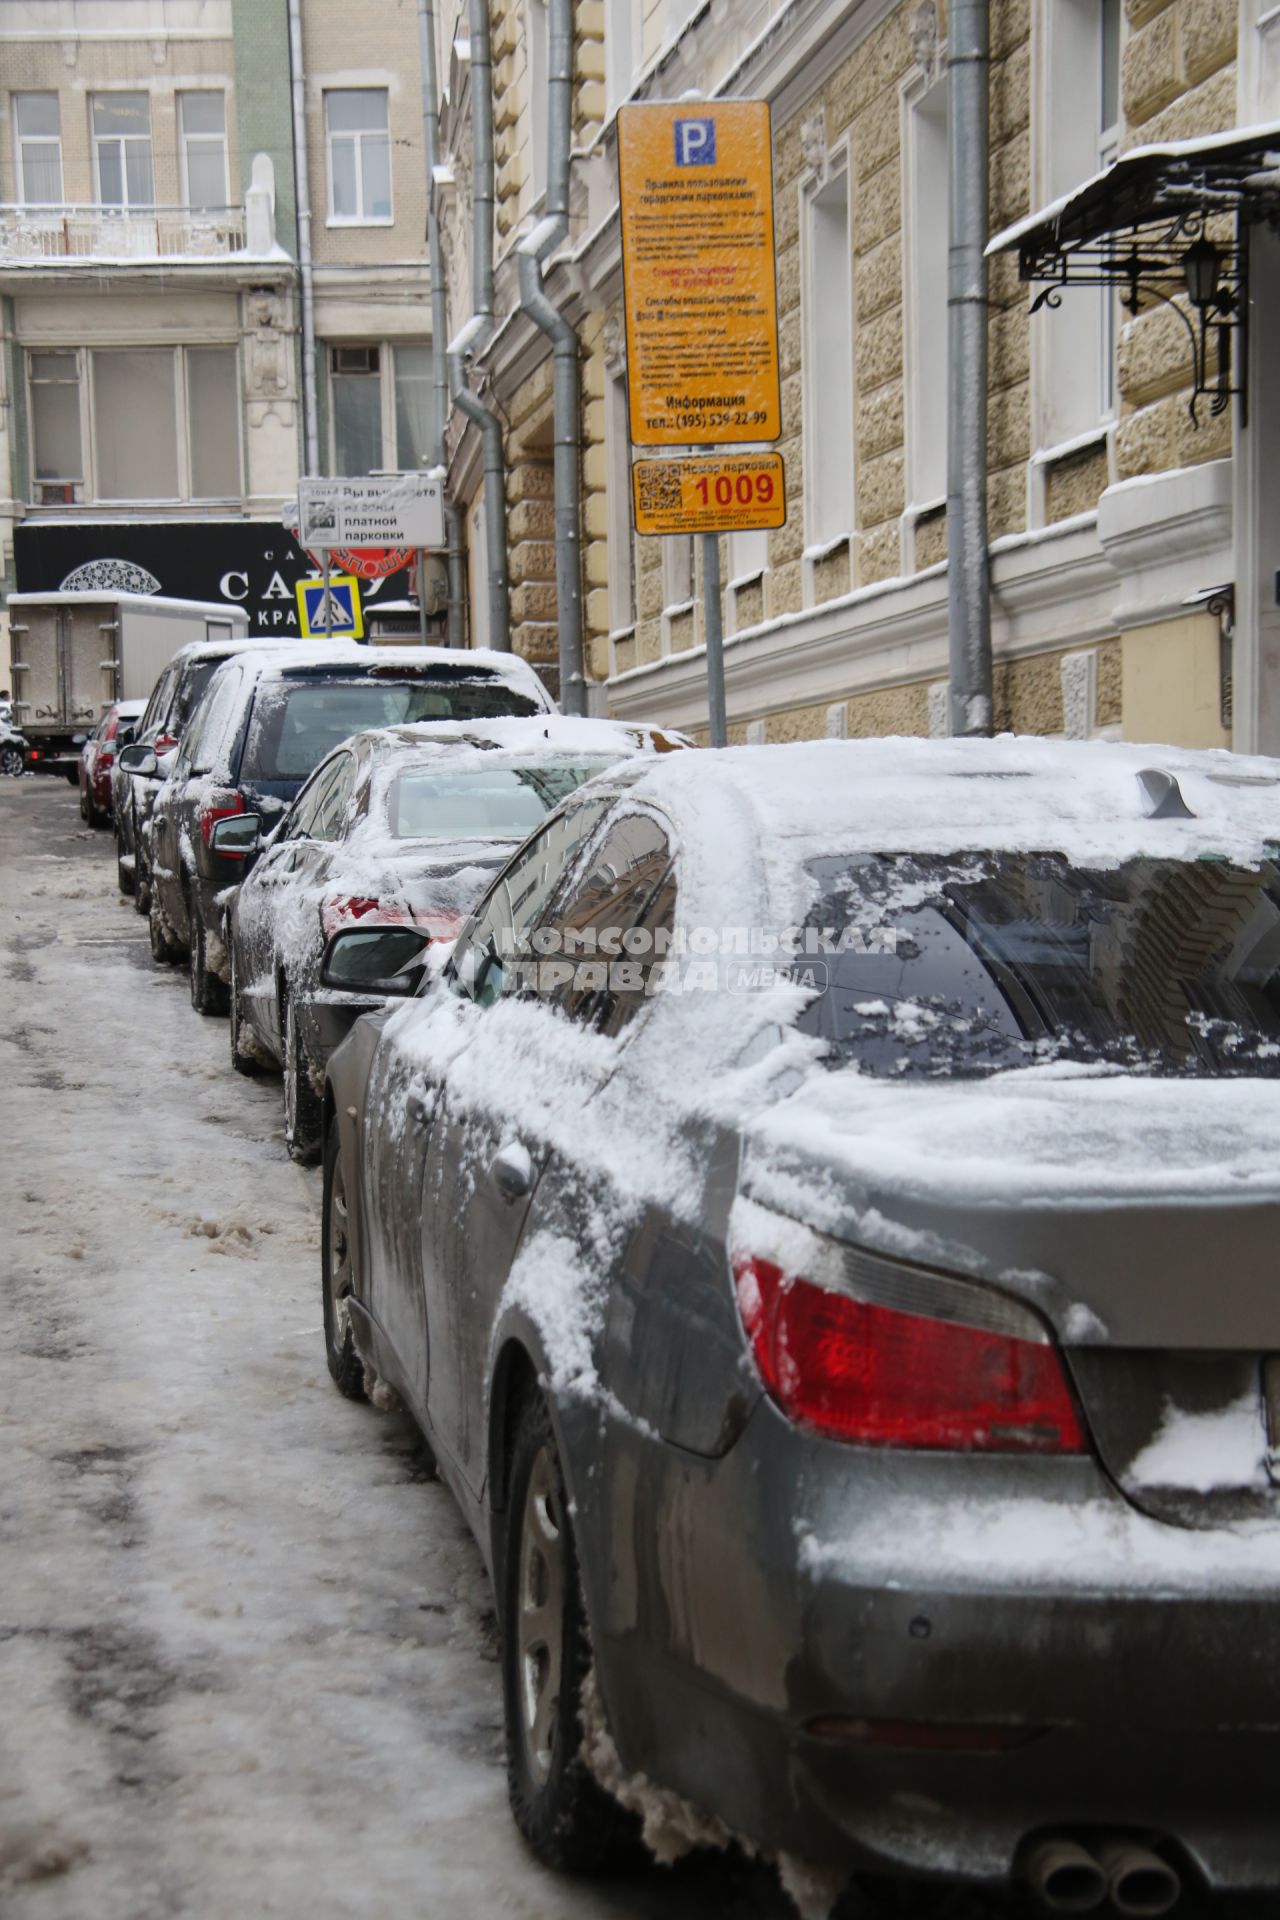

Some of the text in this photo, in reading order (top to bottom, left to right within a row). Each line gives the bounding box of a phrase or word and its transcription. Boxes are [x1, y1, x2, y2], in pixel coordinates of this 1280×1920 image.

[666, 395, 746, 409] Информация
[676, 413, 706, 429] (495)
[709, 411, 768, 427] 539-22-99
[723, 461, 779, 473] парковки
[695, 473, 775, 506] 1009
[344, 515, 397, 527] платной
[345, 530, 404, 542] парковки
